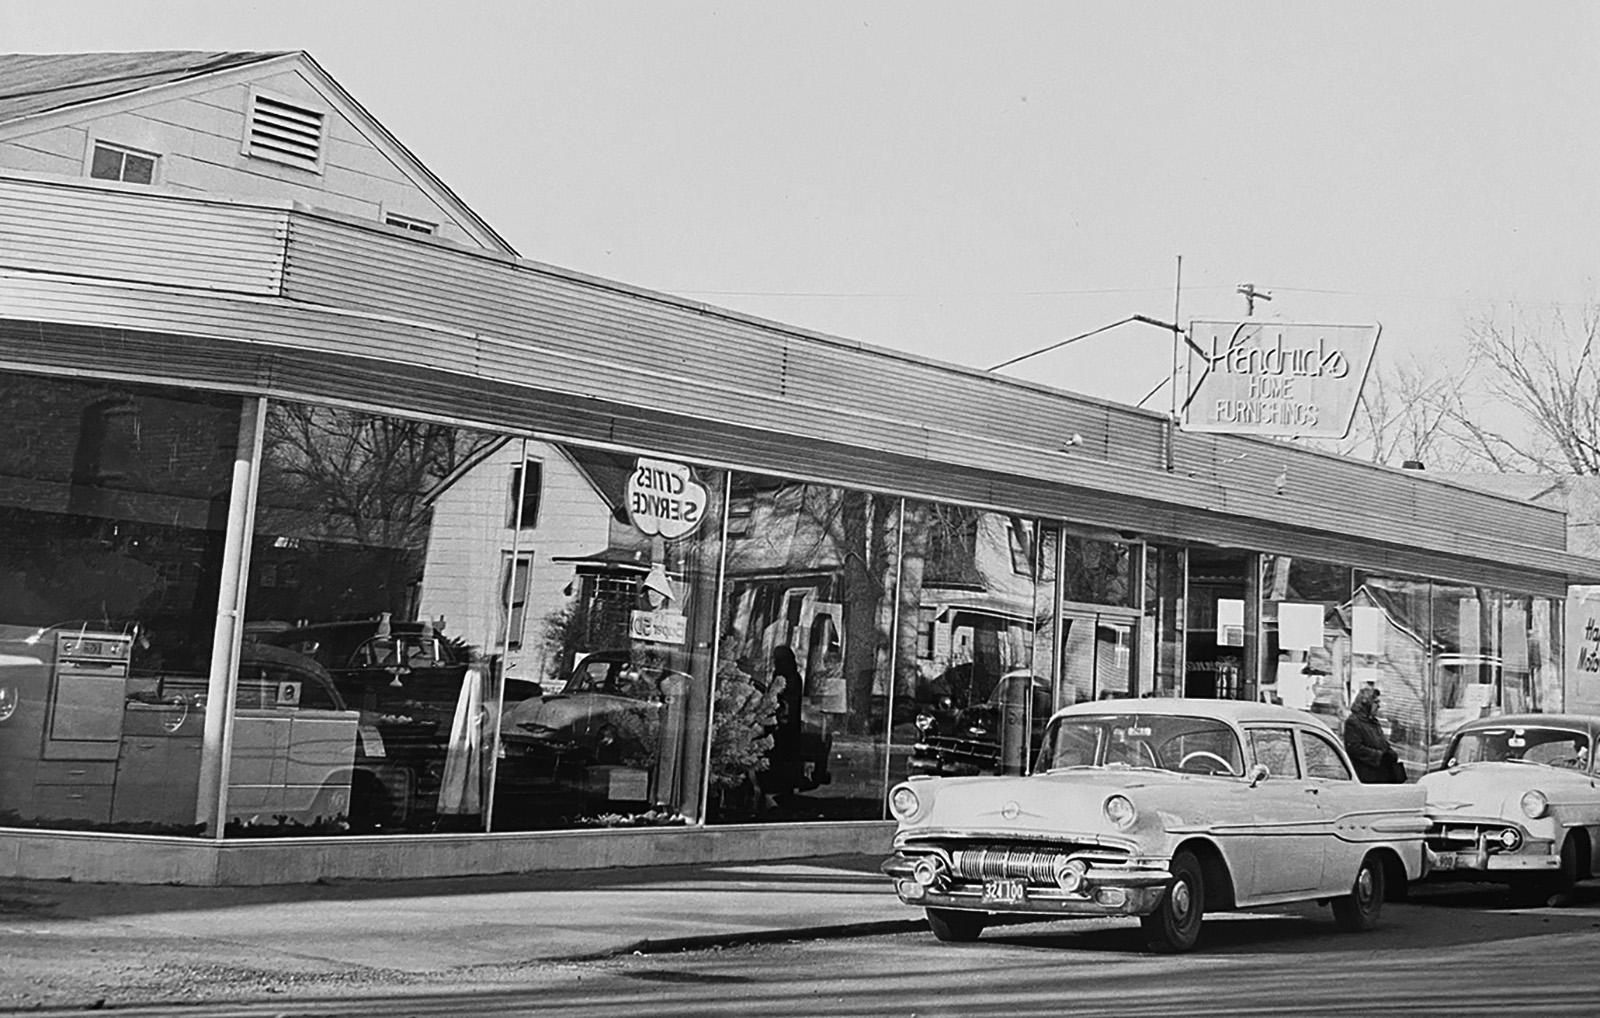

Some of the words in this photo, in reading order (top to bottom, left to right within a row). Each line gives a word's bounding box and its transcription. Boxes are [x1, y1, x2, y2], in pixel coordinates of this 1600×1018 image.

[1210, 324, 1349, 379] Hendricks
[1250, 375, 1294, 400] HOME
[1217, 400, 1319, 427] FURNISHINGS
